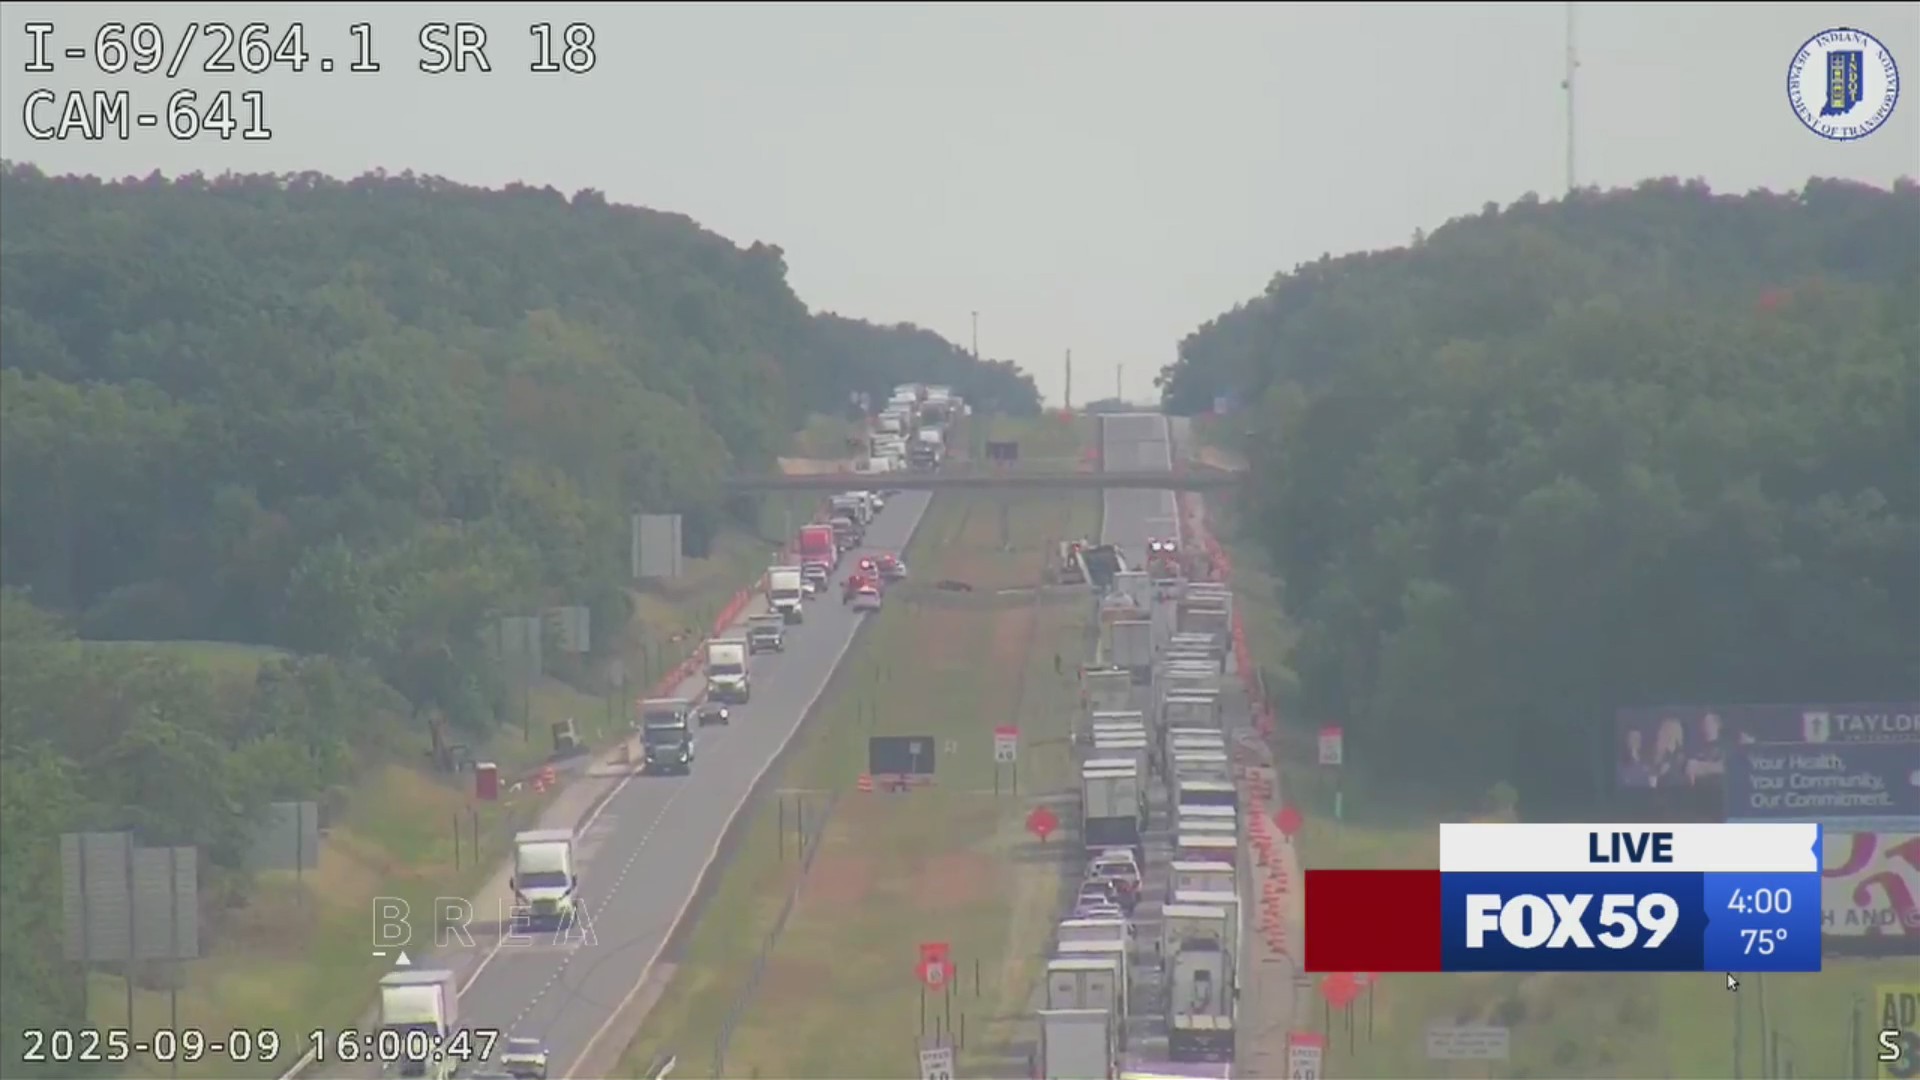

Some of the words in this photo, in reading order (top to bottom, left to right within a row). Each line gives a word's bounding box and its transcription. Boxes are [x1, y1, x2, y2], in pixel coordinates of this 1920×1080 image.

[1749, 753, 1784, 770] Your
[1789, 753, 1846, 772] Health,
[1751, 792, 1782, 808] Our
[1845, 909, 1895, 925] AND
